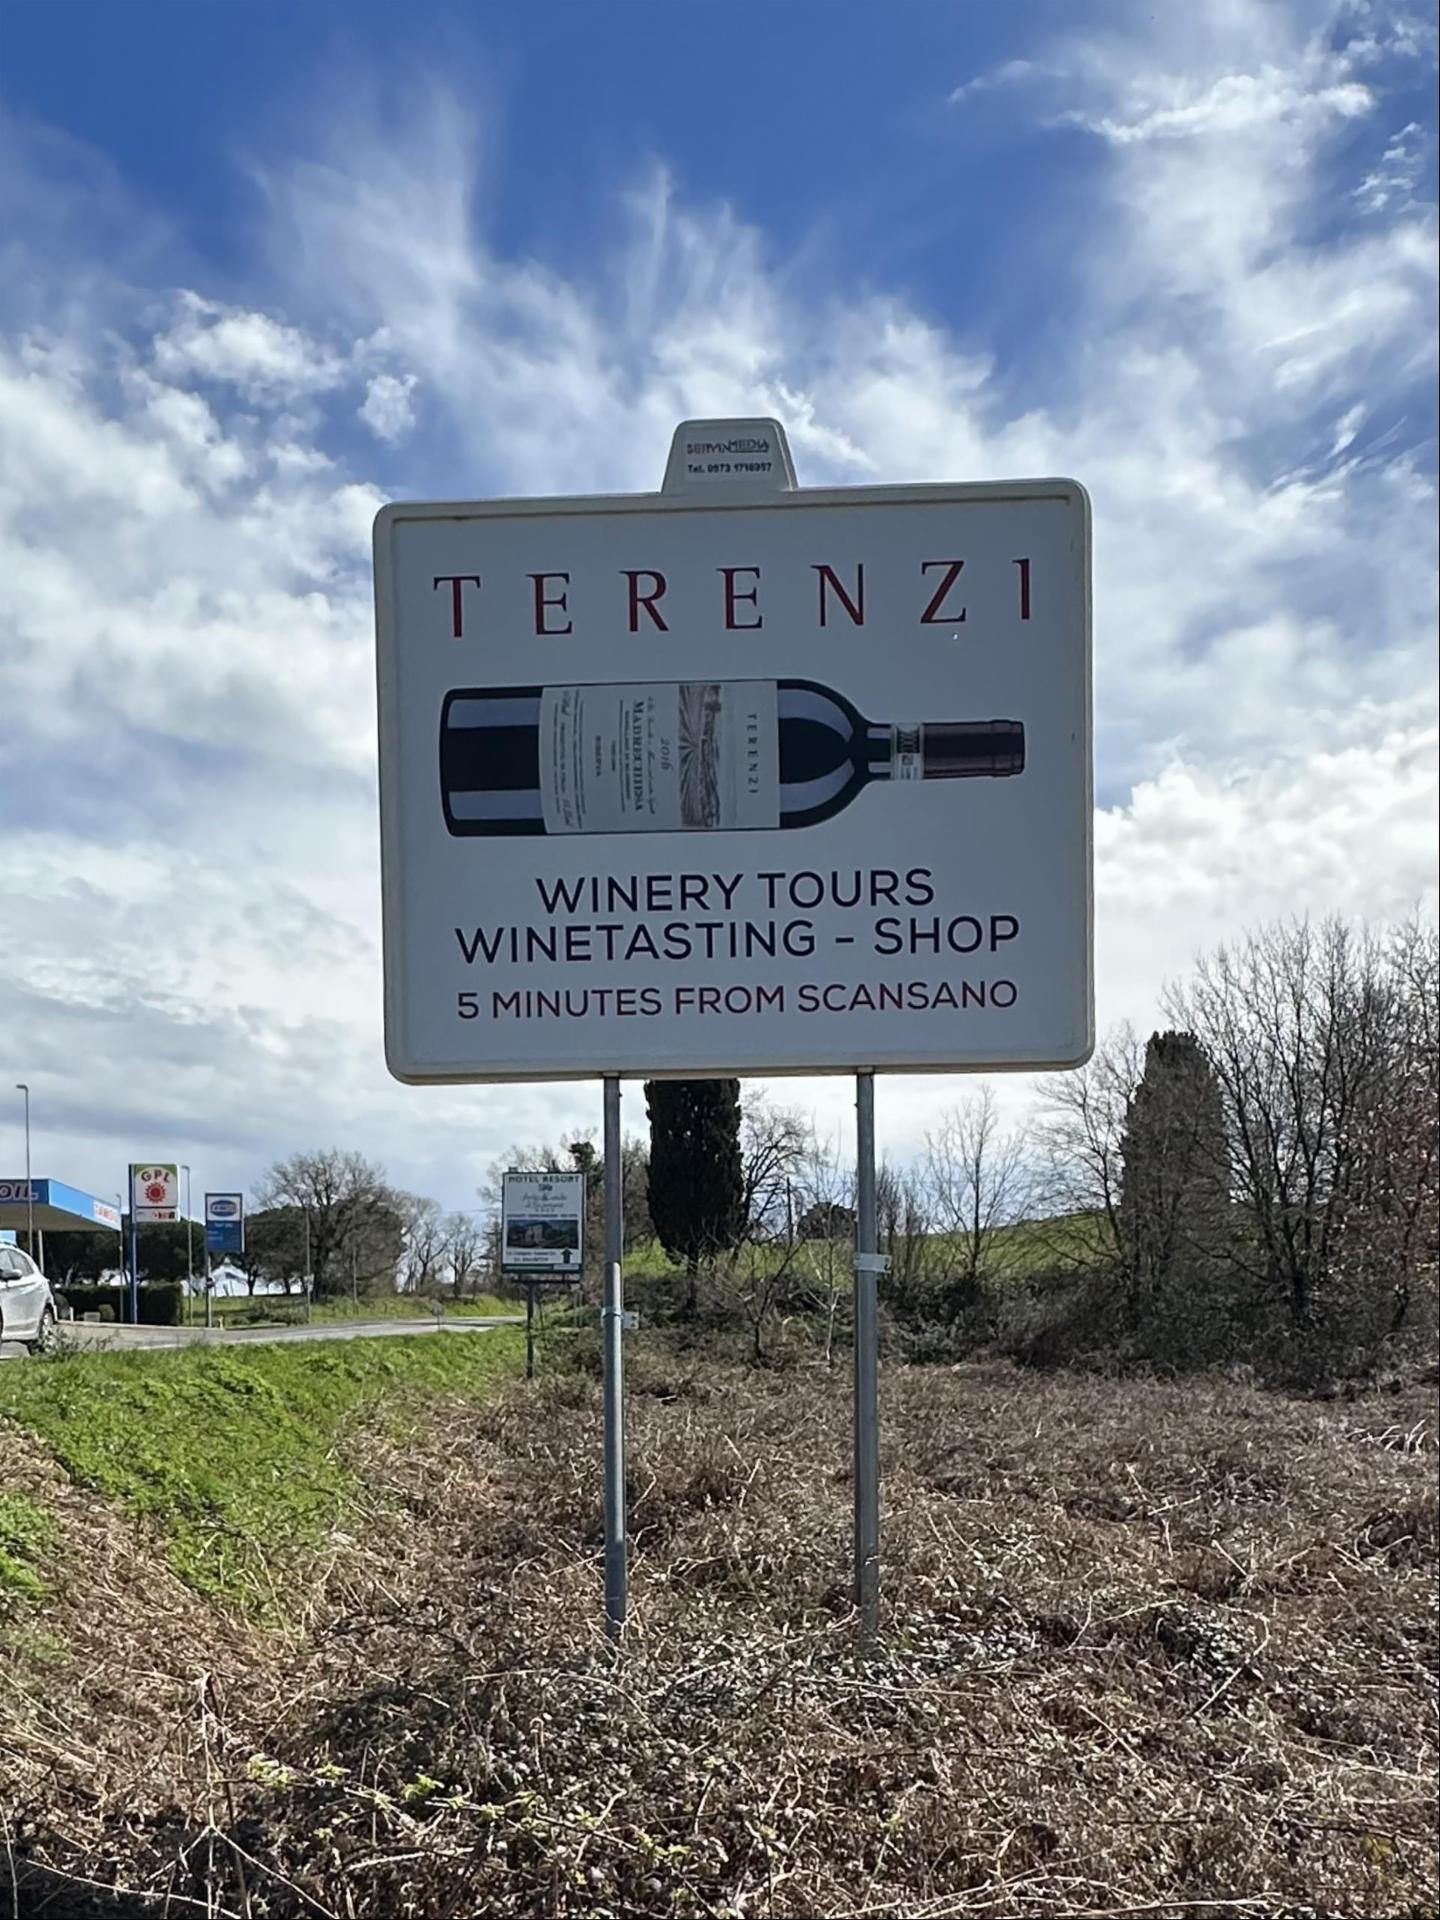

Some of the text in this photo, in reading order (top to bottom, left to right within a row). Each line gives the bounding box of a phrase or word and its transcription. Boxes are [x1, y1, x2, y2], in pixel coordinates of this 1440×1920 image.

[433, 557, 1031, 638] TERENZI
[746, 713, 759, 794] TERENZI
[535, 868, 934, 914] WINERY TOURS
[454, 919, 815, 964] WINETASTING
[874, 915, 1020, 955] SHOP
[458, 980, 1018, 1019] 5 MINUTES FROM SCANSANO
[141, 1169, 170, 1183] GPL
[508, 1175, 580, 1183] HOTEL RESORT
